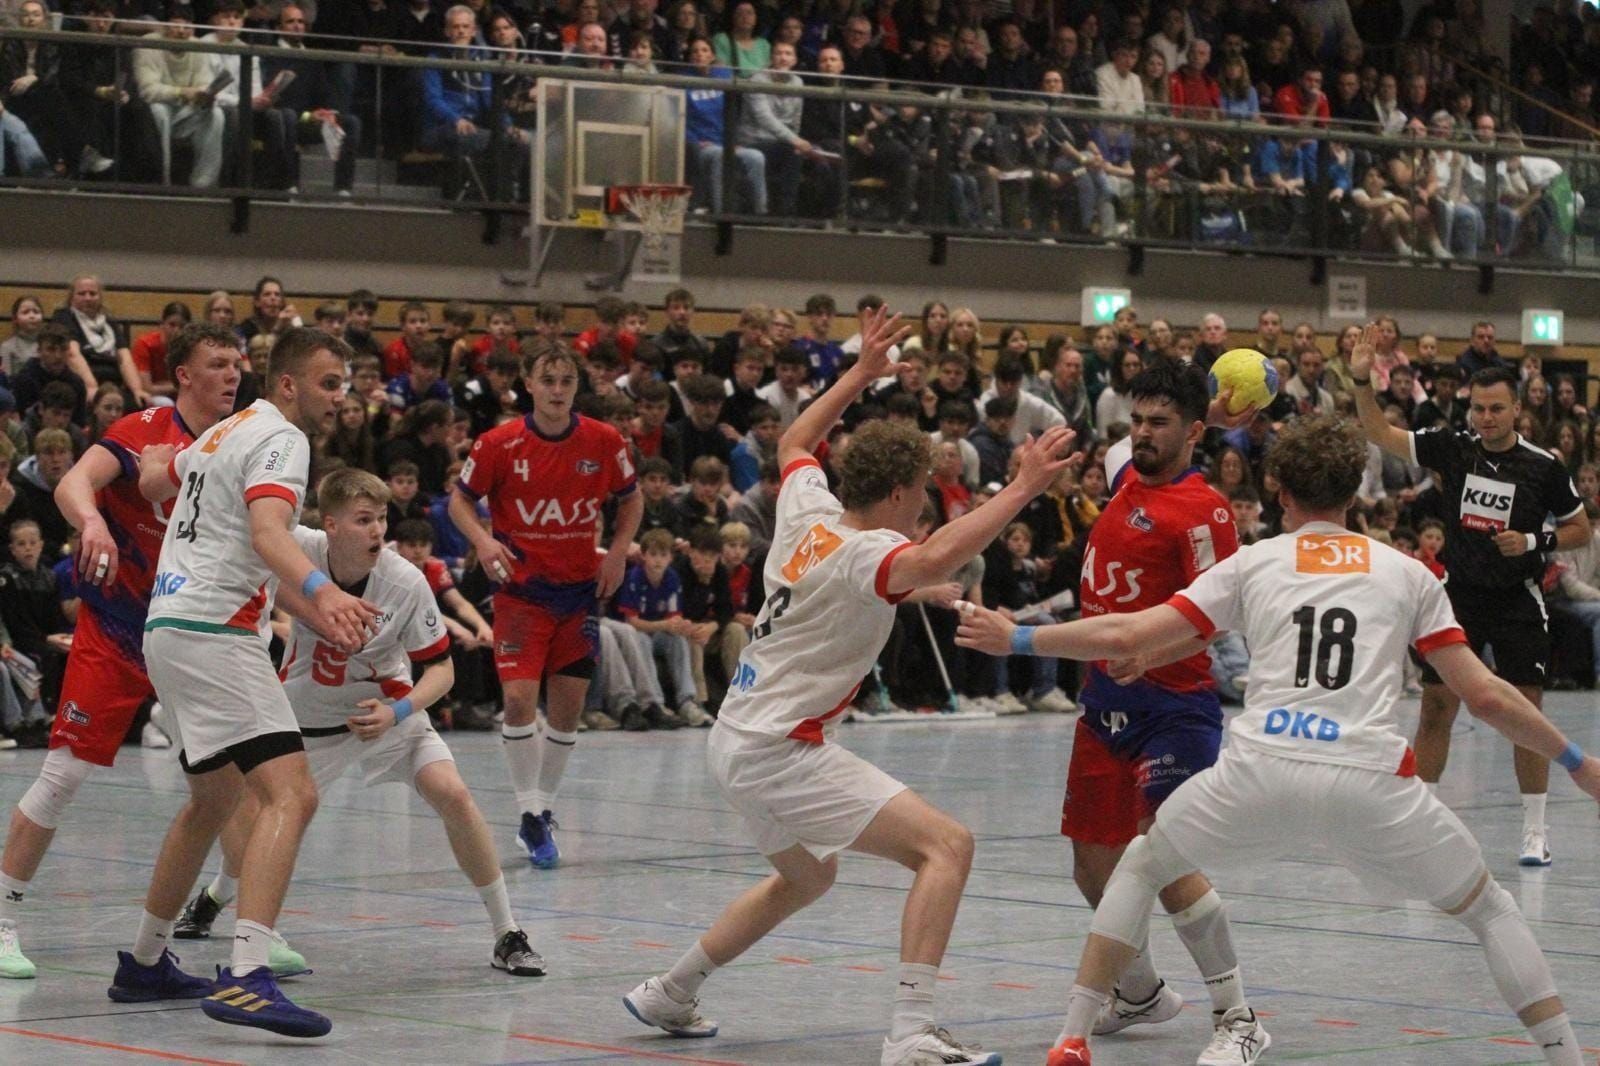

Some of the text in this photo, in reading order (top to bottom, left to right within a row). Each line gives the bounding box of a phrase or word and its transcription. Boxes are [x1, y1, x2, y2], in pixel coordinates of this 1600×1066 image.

[264, 450, 280, 471] B&O
[274, 437, 297, 473] SERVICE
[513, 459, 529, 482] 4
[515, 498, 600, 526] VASS
[1463, 487, 1512, 512] KÜS
[1080, 543, 1144, 603] ASS
[1293, 605, 1357, 691] 18
[1263, 708, 1341, 743] DKB
